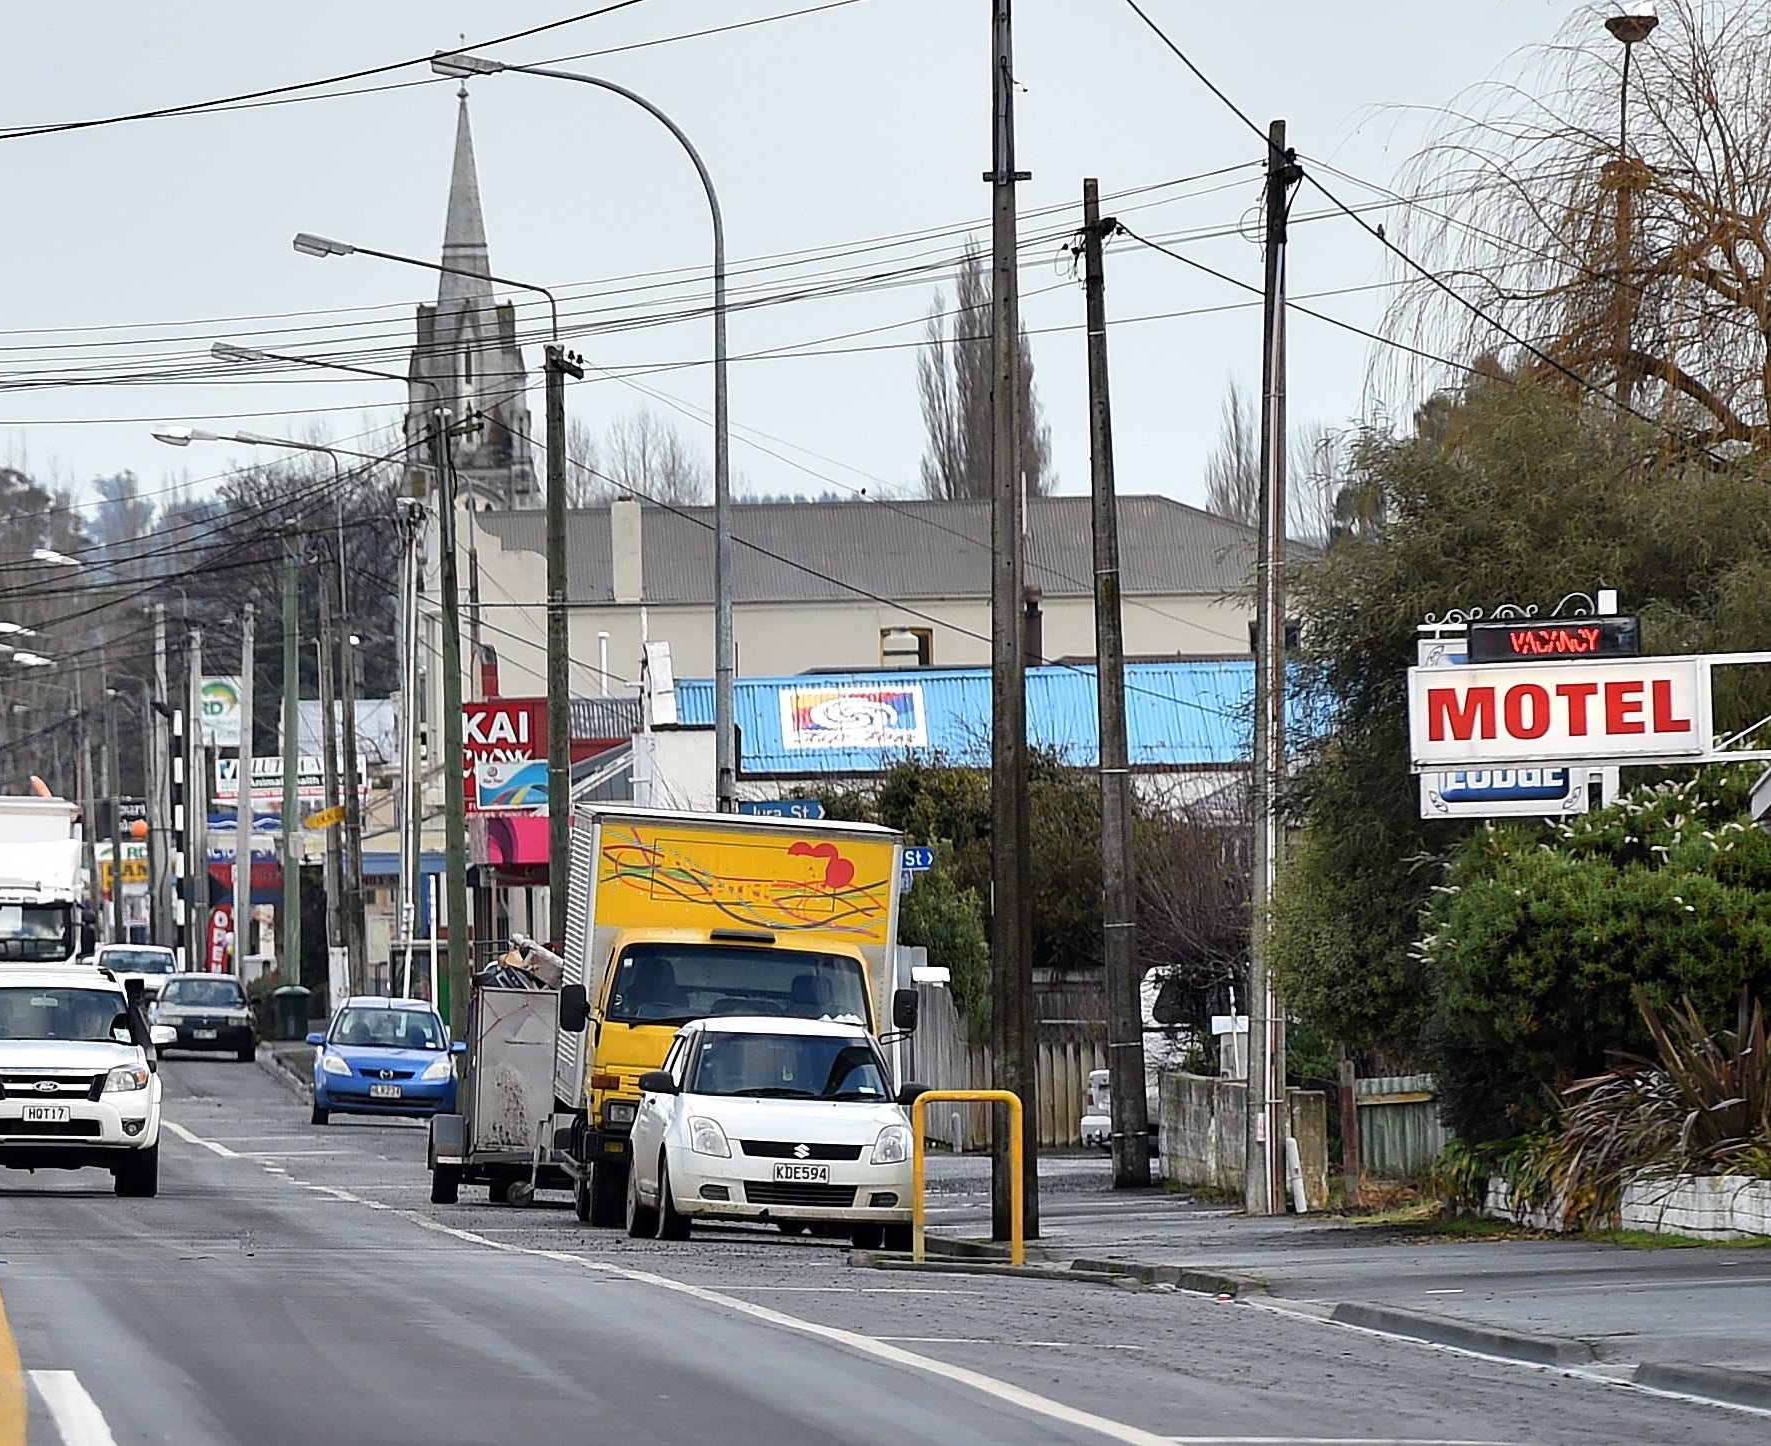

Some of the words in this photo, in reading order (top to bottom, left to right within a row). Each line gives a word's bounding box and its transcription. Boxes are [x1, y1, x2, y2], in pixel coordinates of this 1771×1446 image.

[1510, 628, 1600, 655] VACANCY
[1428, 680, 1691, 741] MOTEL
[462, 711, 528, 744] KAI
[790, 804, 809, 819] St
[904, 851, 922, 866] St
[776, 1165, 827, 1181] KDE594
